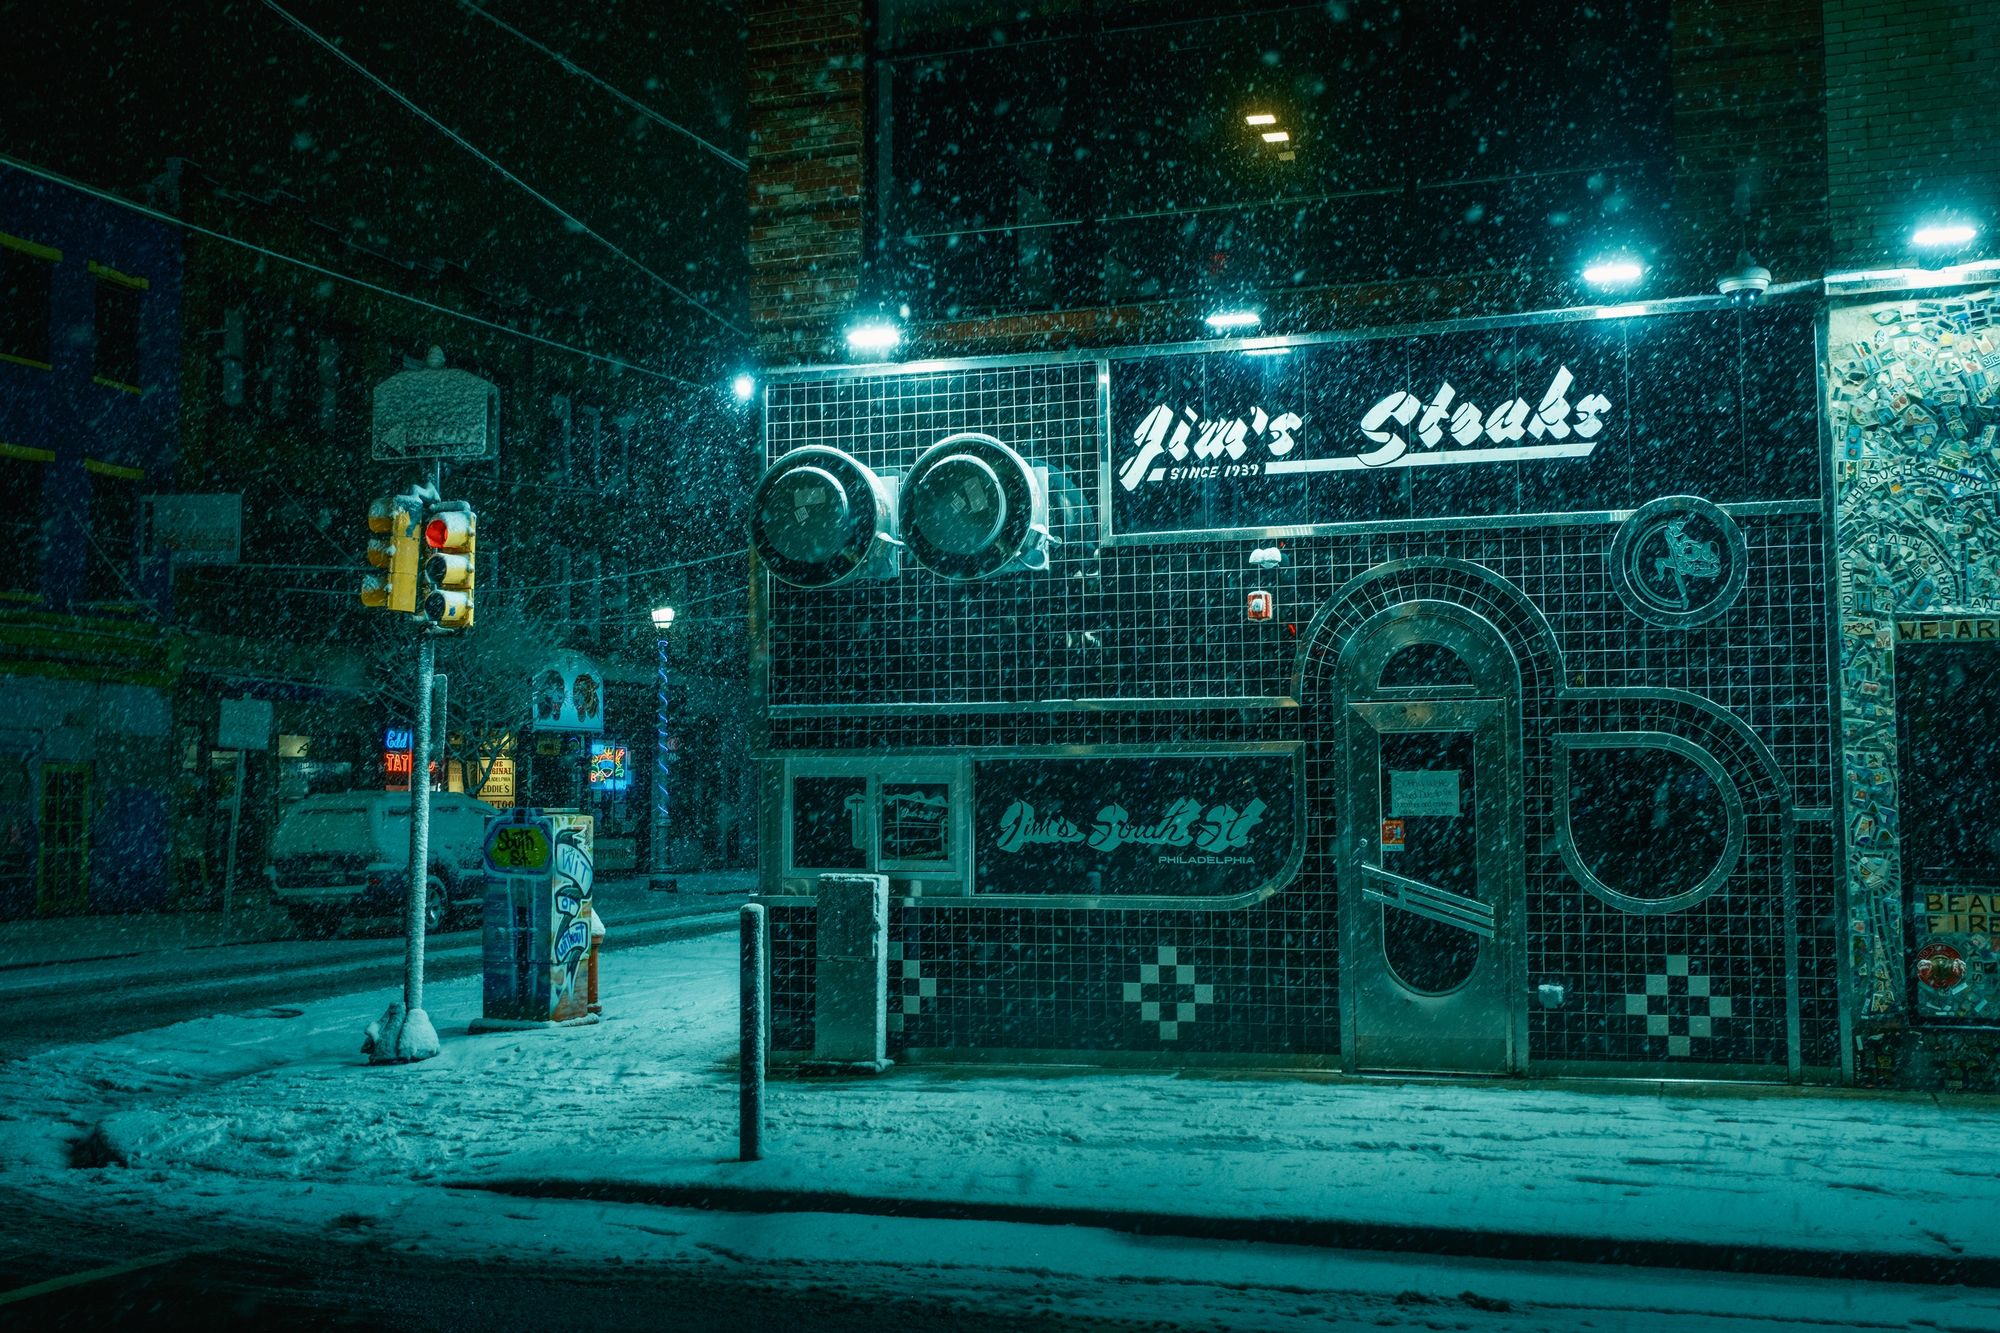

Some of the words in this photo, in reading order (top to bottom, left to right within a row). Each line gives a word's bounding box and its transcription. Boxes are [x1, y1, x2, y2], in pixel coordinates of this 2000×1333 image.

[1119, 404, 1303, 492] Jim's
[1357, 365, 1612, 467] Steaks
[1170, 467, 1218, 481] SINCE
[1223, 463, 1260, 478] 1939
[1844, 465, 1913, 507] THROUGH
[1927, 466, 1982, 491] STORY
[1898, 621, 1940, 640] WE
[482, 784, 510, 793] EDDIE'S
[996, 798, 1085, 852] Jim's
[1087, 798, 1197, 852] South
[497, 828, 534, 852] South
[1158, 855, 1256, 865] PHILADELPHIA
